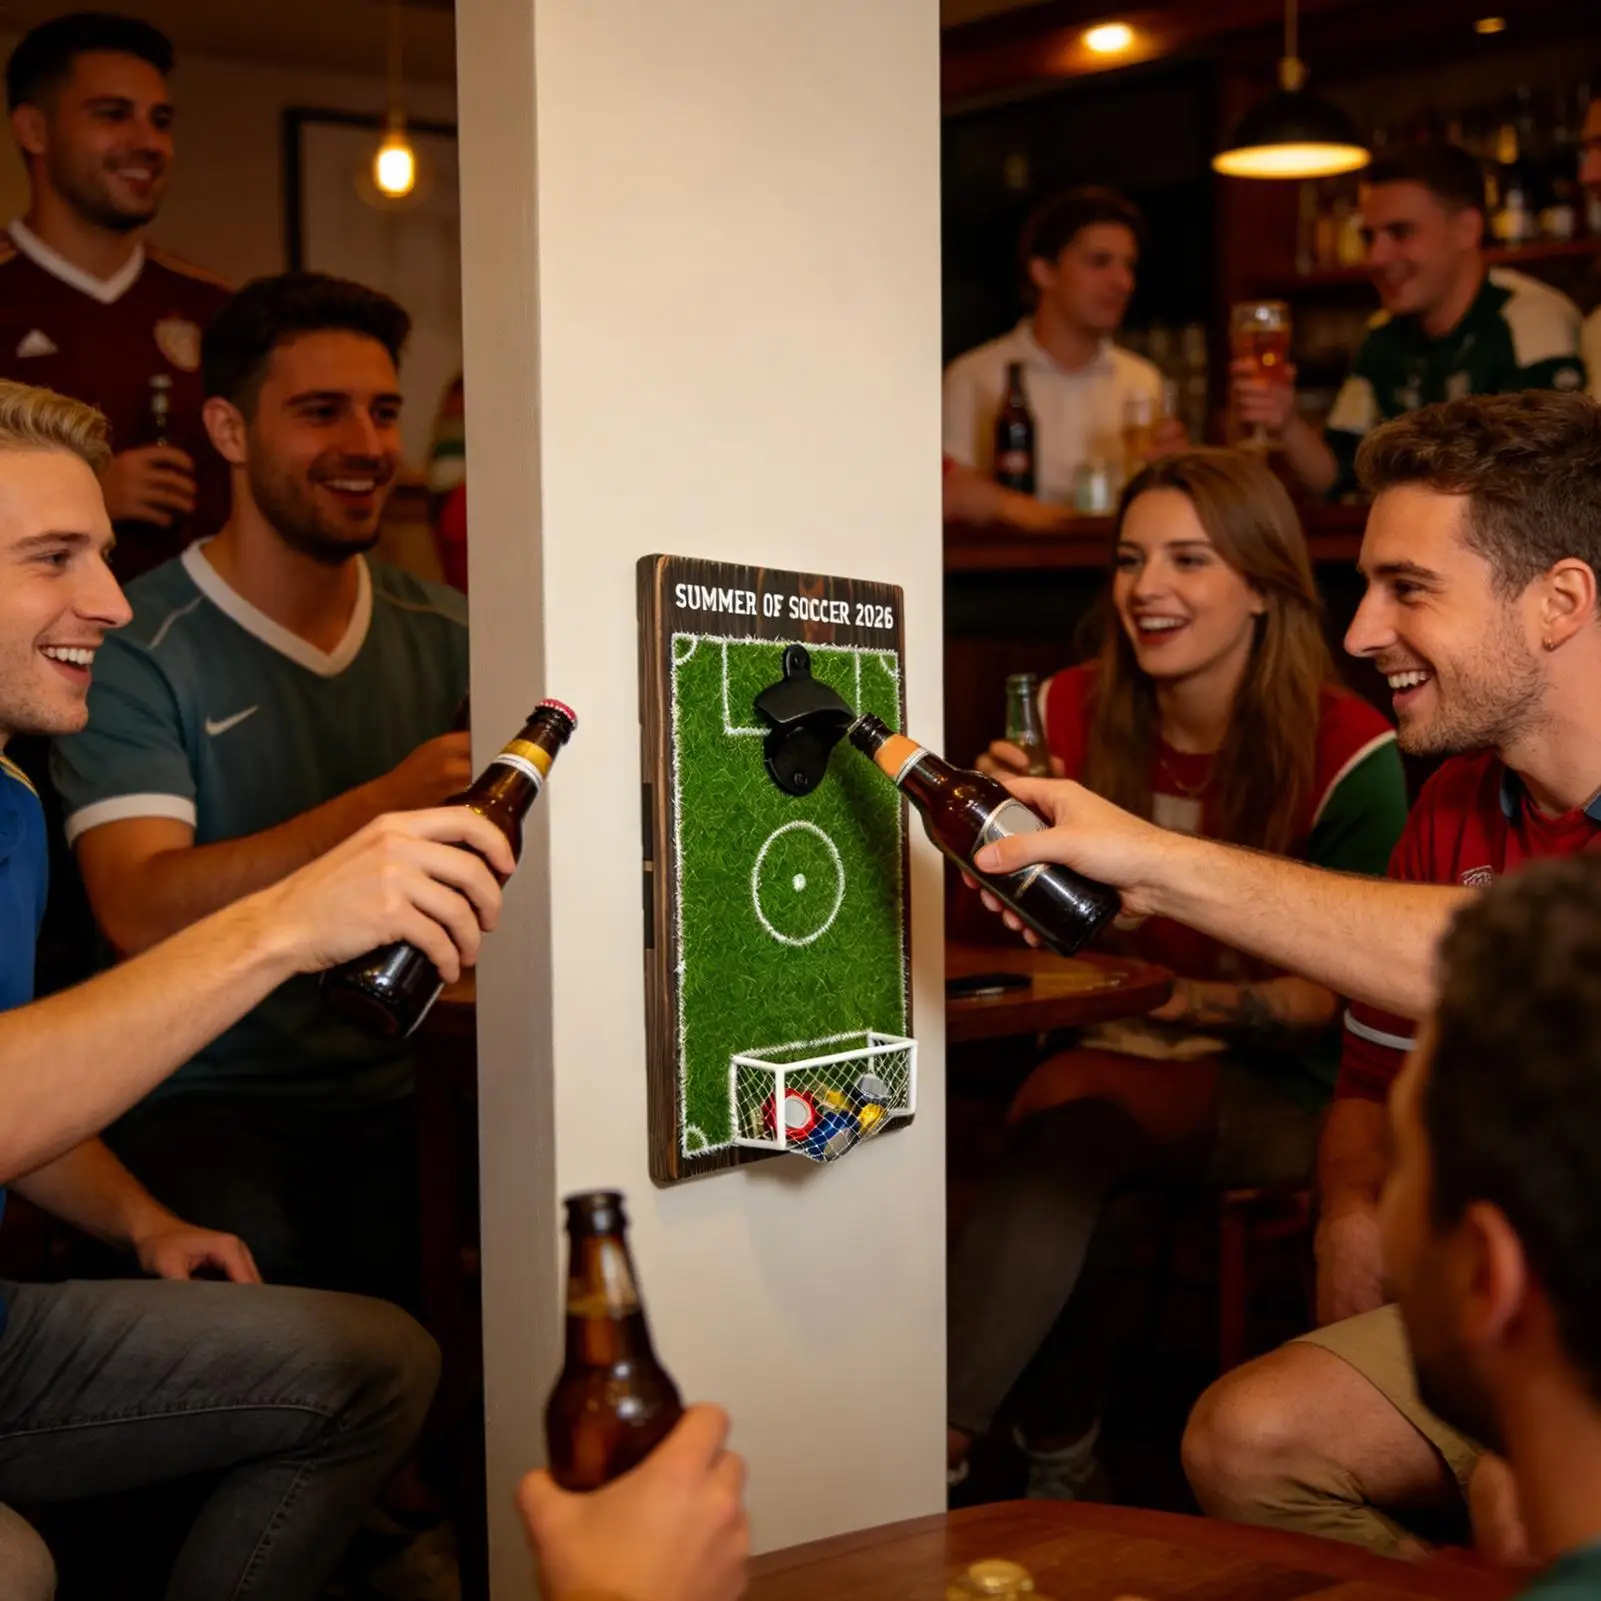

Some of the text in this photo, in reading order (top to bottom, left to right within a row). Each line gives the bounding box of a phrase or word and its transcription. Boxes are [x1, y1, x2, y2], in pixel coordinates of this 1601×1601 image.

[675, 583, 894, 630] SUMMER OF SOCCER 2026
